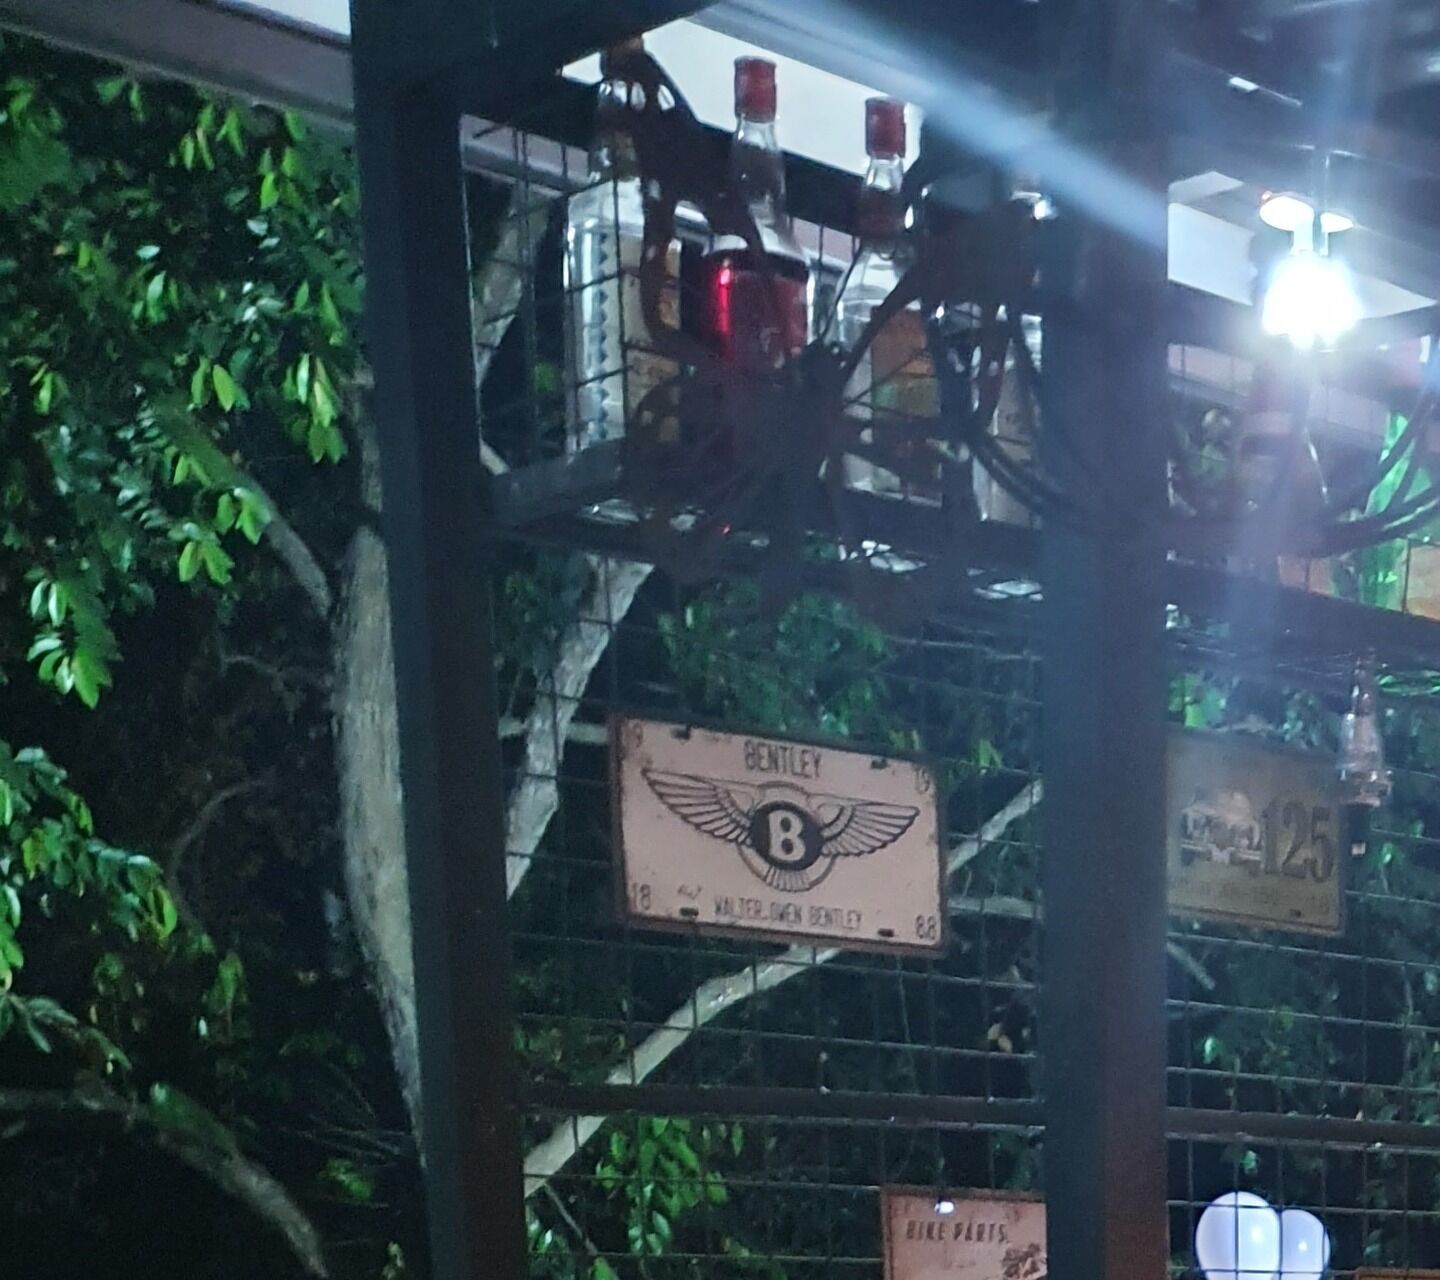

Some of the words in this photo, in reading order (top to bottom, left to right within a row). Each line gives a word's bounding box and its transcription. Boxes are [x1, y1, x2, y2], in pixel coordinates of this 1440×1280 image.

[744, 739, 822, 778] BENTLEY
[1263, 800, 1334, 883] 125
[809, 905, 862, 931] BENTLEY
[906, 1219, 946, 1241] BIKE
[953, 1221, 1009, 1244] PARTS
